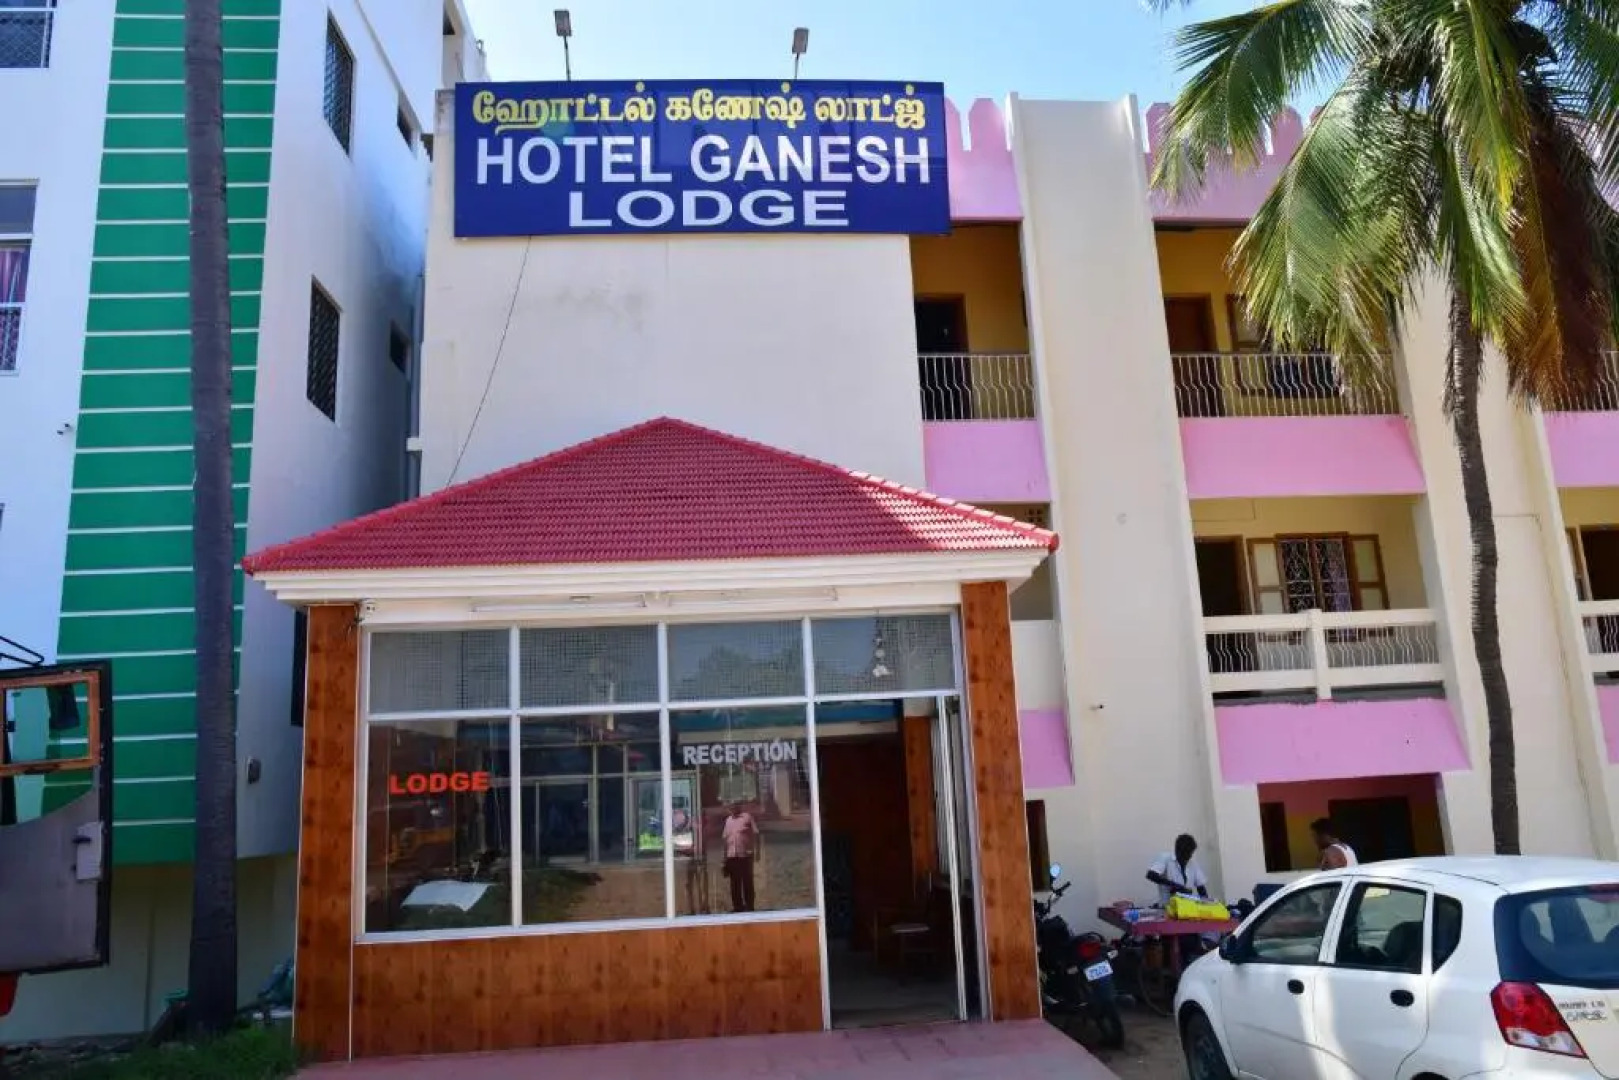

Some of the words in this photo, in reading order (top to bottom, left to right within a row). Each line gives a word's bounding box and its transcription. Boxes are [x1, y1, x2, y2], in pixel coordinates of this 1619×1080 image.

[472, 82, 656, 135] ஹோட்டல்
[665, 82, 806, 128] கணேஷ்
[815, 84, 926, 130] லாட்ஜ்
[476, 136, 673, 185] HOTEL
[689, 134, 930, 184] GANESH
[569, 189, 849, 227] LODGE
[682, 740, 798, 765] RECEPTION
[390, 771, 490, 794] LODGE
